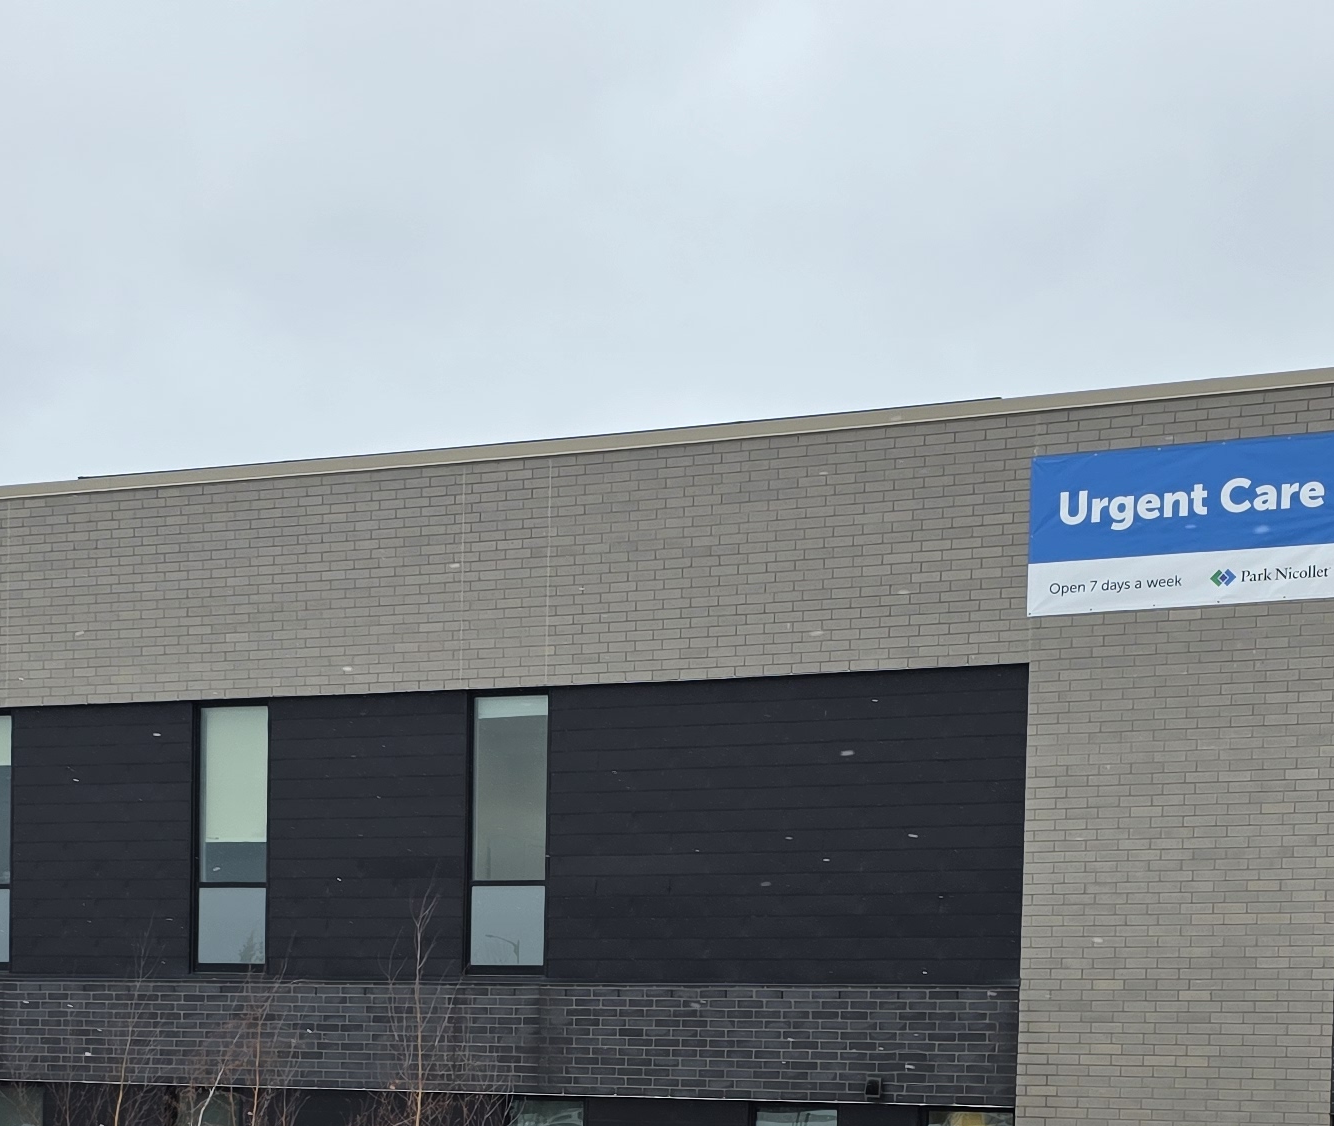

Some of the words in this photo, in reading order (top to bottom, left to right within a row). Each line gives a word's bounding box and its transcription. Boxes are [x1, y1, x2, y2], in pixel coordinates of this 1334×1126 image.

[1059, 483, 1208, 531] Urgent
[1220, 477, 1325, 513] Care
[1241, 568, 1272, 582] Park
[1275, 565, 1329, 581] Nicollet
[1049, 583, 1086, 597] Open
[1090, 580, 1098, 592] 7
[1101, 579, 1131, 593] days
[1134, 580, 1142, 589] a
[1146, 575, 1182, 588] week
